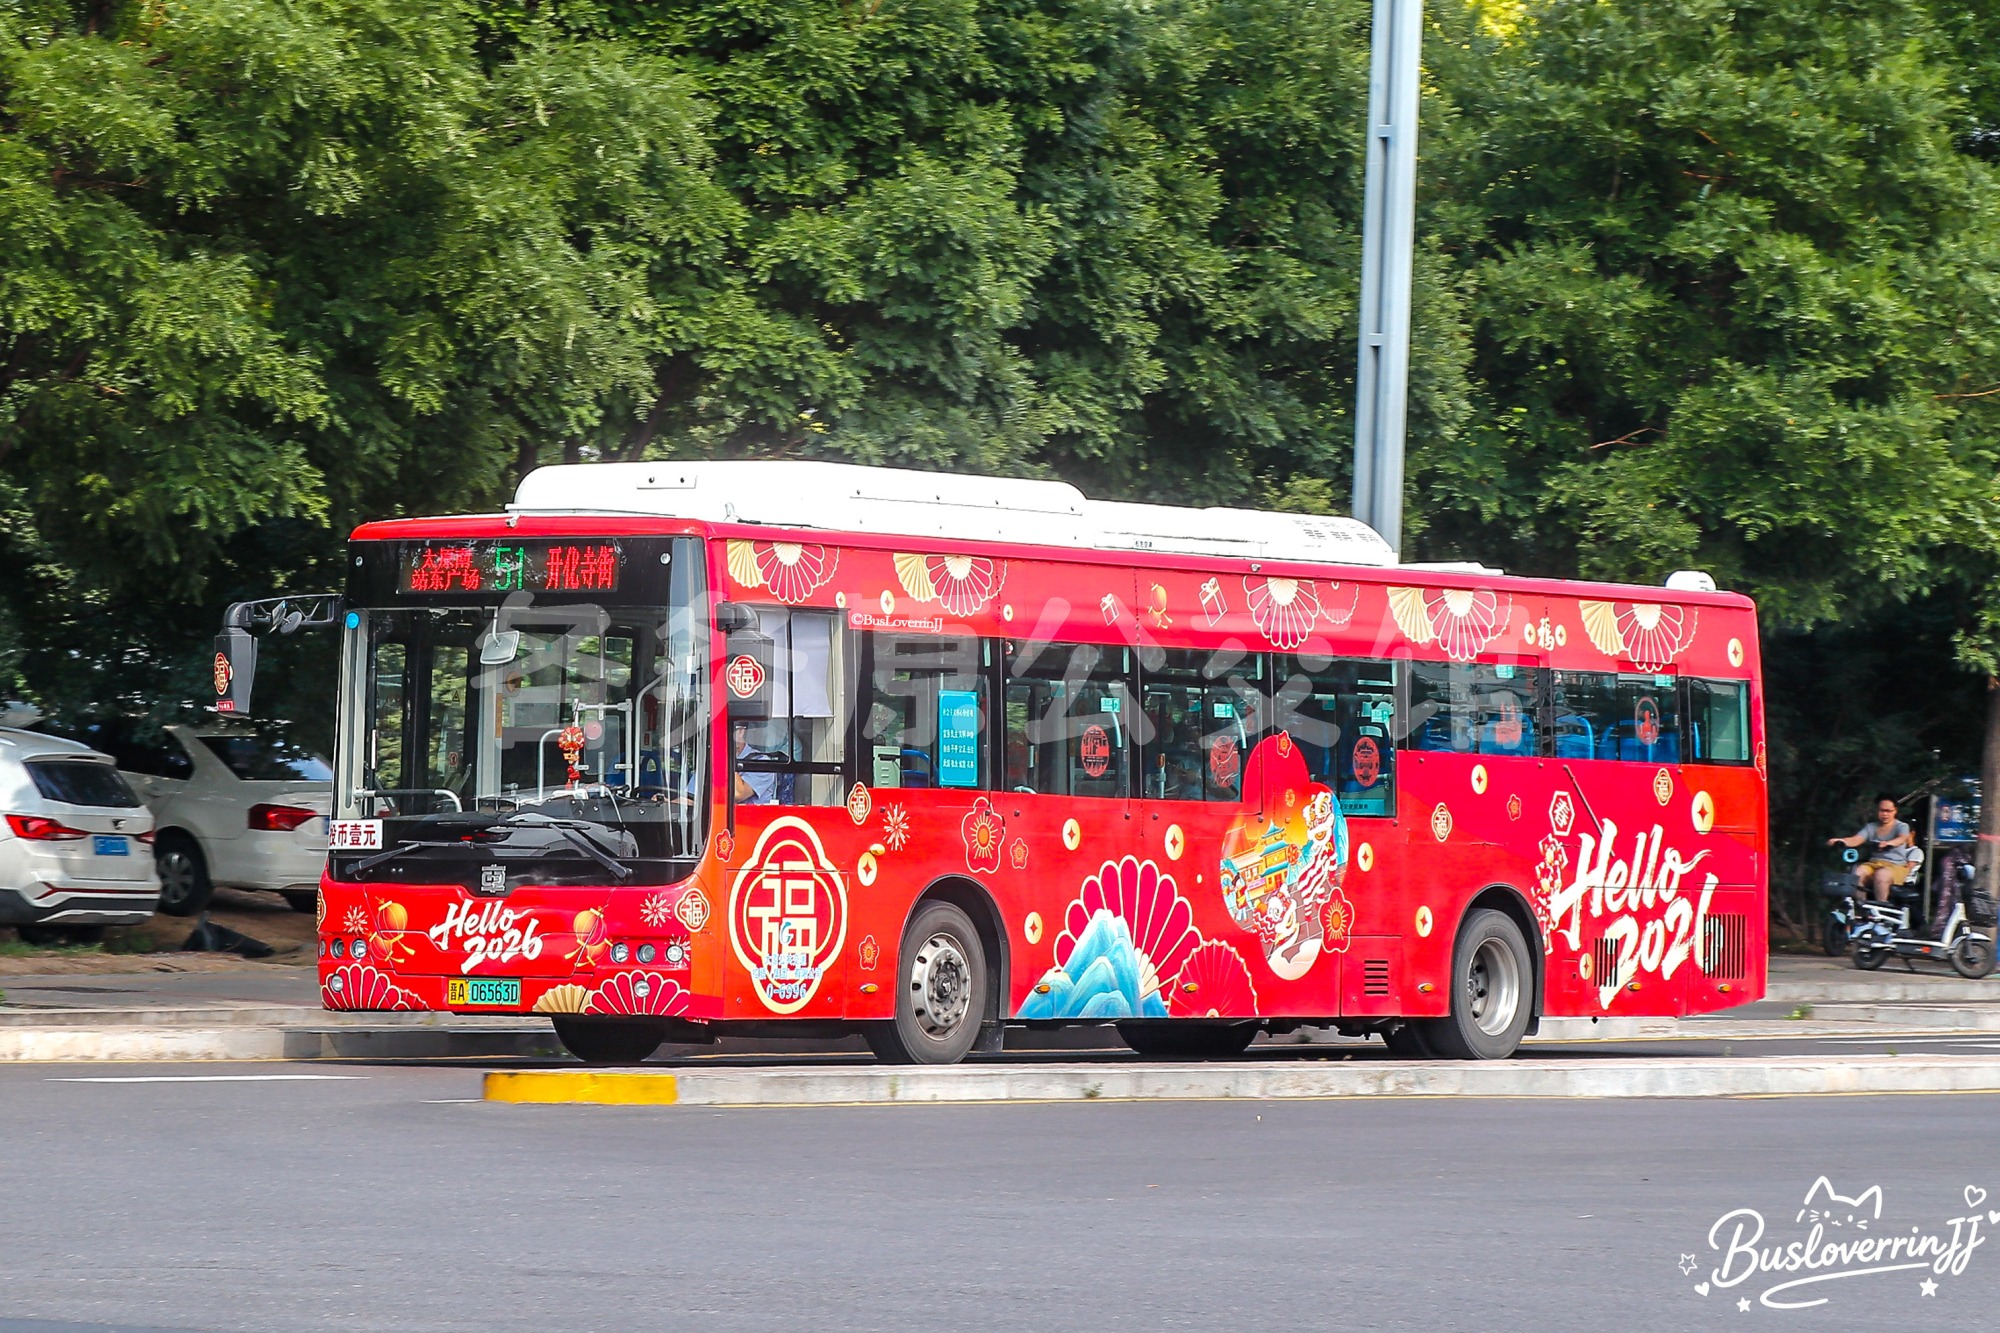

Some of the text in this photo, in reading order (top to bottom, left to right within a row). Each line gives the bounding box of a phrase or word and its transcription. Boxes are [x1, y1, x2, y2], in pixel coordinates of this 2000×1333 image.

[411, 569, 481, 591] 站东广场
[421, 548, 473, 569] 太原南
[495, 547, 525, 591] 51
[545, 547, 615, 590] 开化寺街
[1550, 818, 1713, 951] Hello
[429, 898, 537, 951] Hello
[748, 859, 818, 980] 福
[1599, 873, 1724, 1010] 2026
[460, 918, 543, 975] 2026
